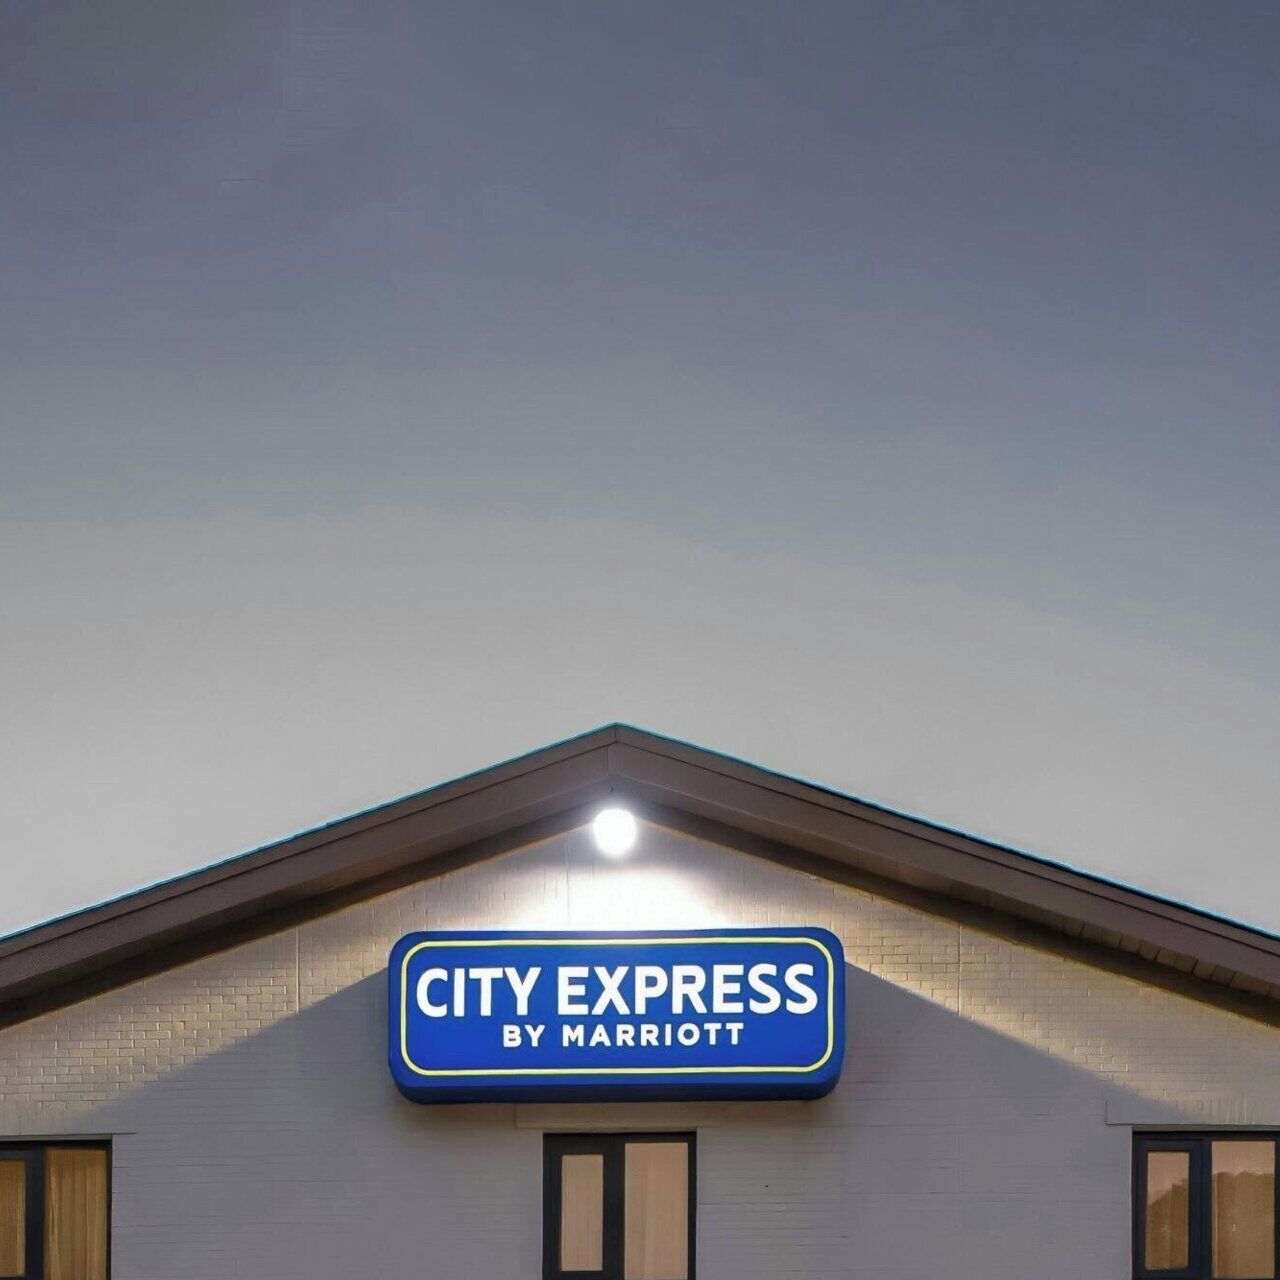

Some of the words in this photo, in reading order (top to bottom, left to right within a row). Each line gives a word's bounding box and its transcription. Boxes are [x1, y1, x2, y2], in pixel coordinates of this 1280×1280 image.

[416, 966, 542, 1018] CITY
[557, 963, 818, 1016] EXPRESS
[503, 1025, 545, 1048] BY
[562, 1022, 744, 1047] MARRIOTT
